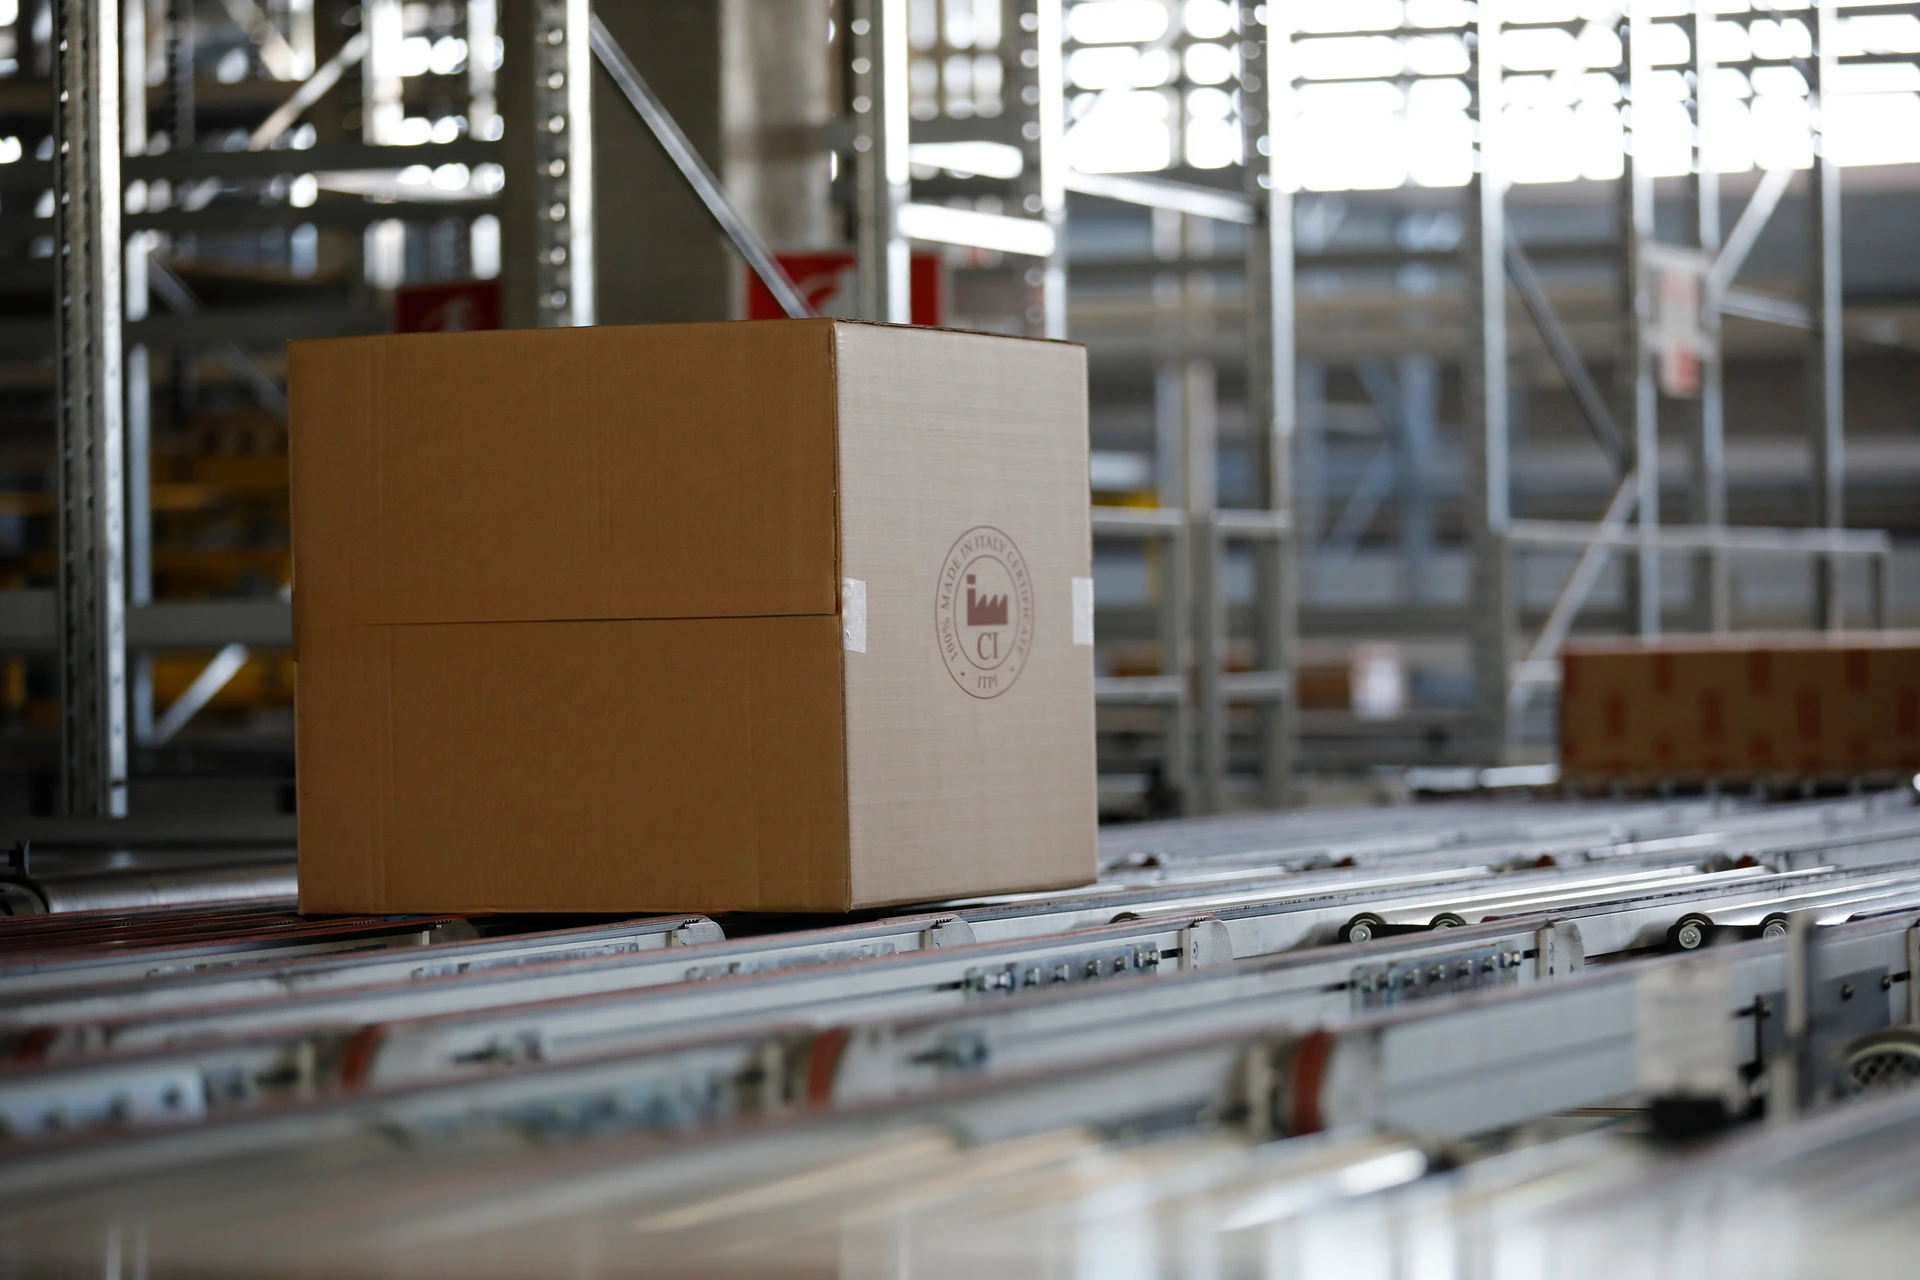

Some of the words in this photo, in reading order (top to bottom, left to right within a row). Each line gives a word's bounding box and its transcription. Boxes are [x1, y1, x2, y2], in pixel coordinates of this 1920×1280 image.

[941, 557, 962, 610] MADE
[960, 540, 973, 559] IN
[975, 535, 1006, 554] ITALY
[976, 632, 999, 660] CI
[977, 675, 998, 689] ITPI
